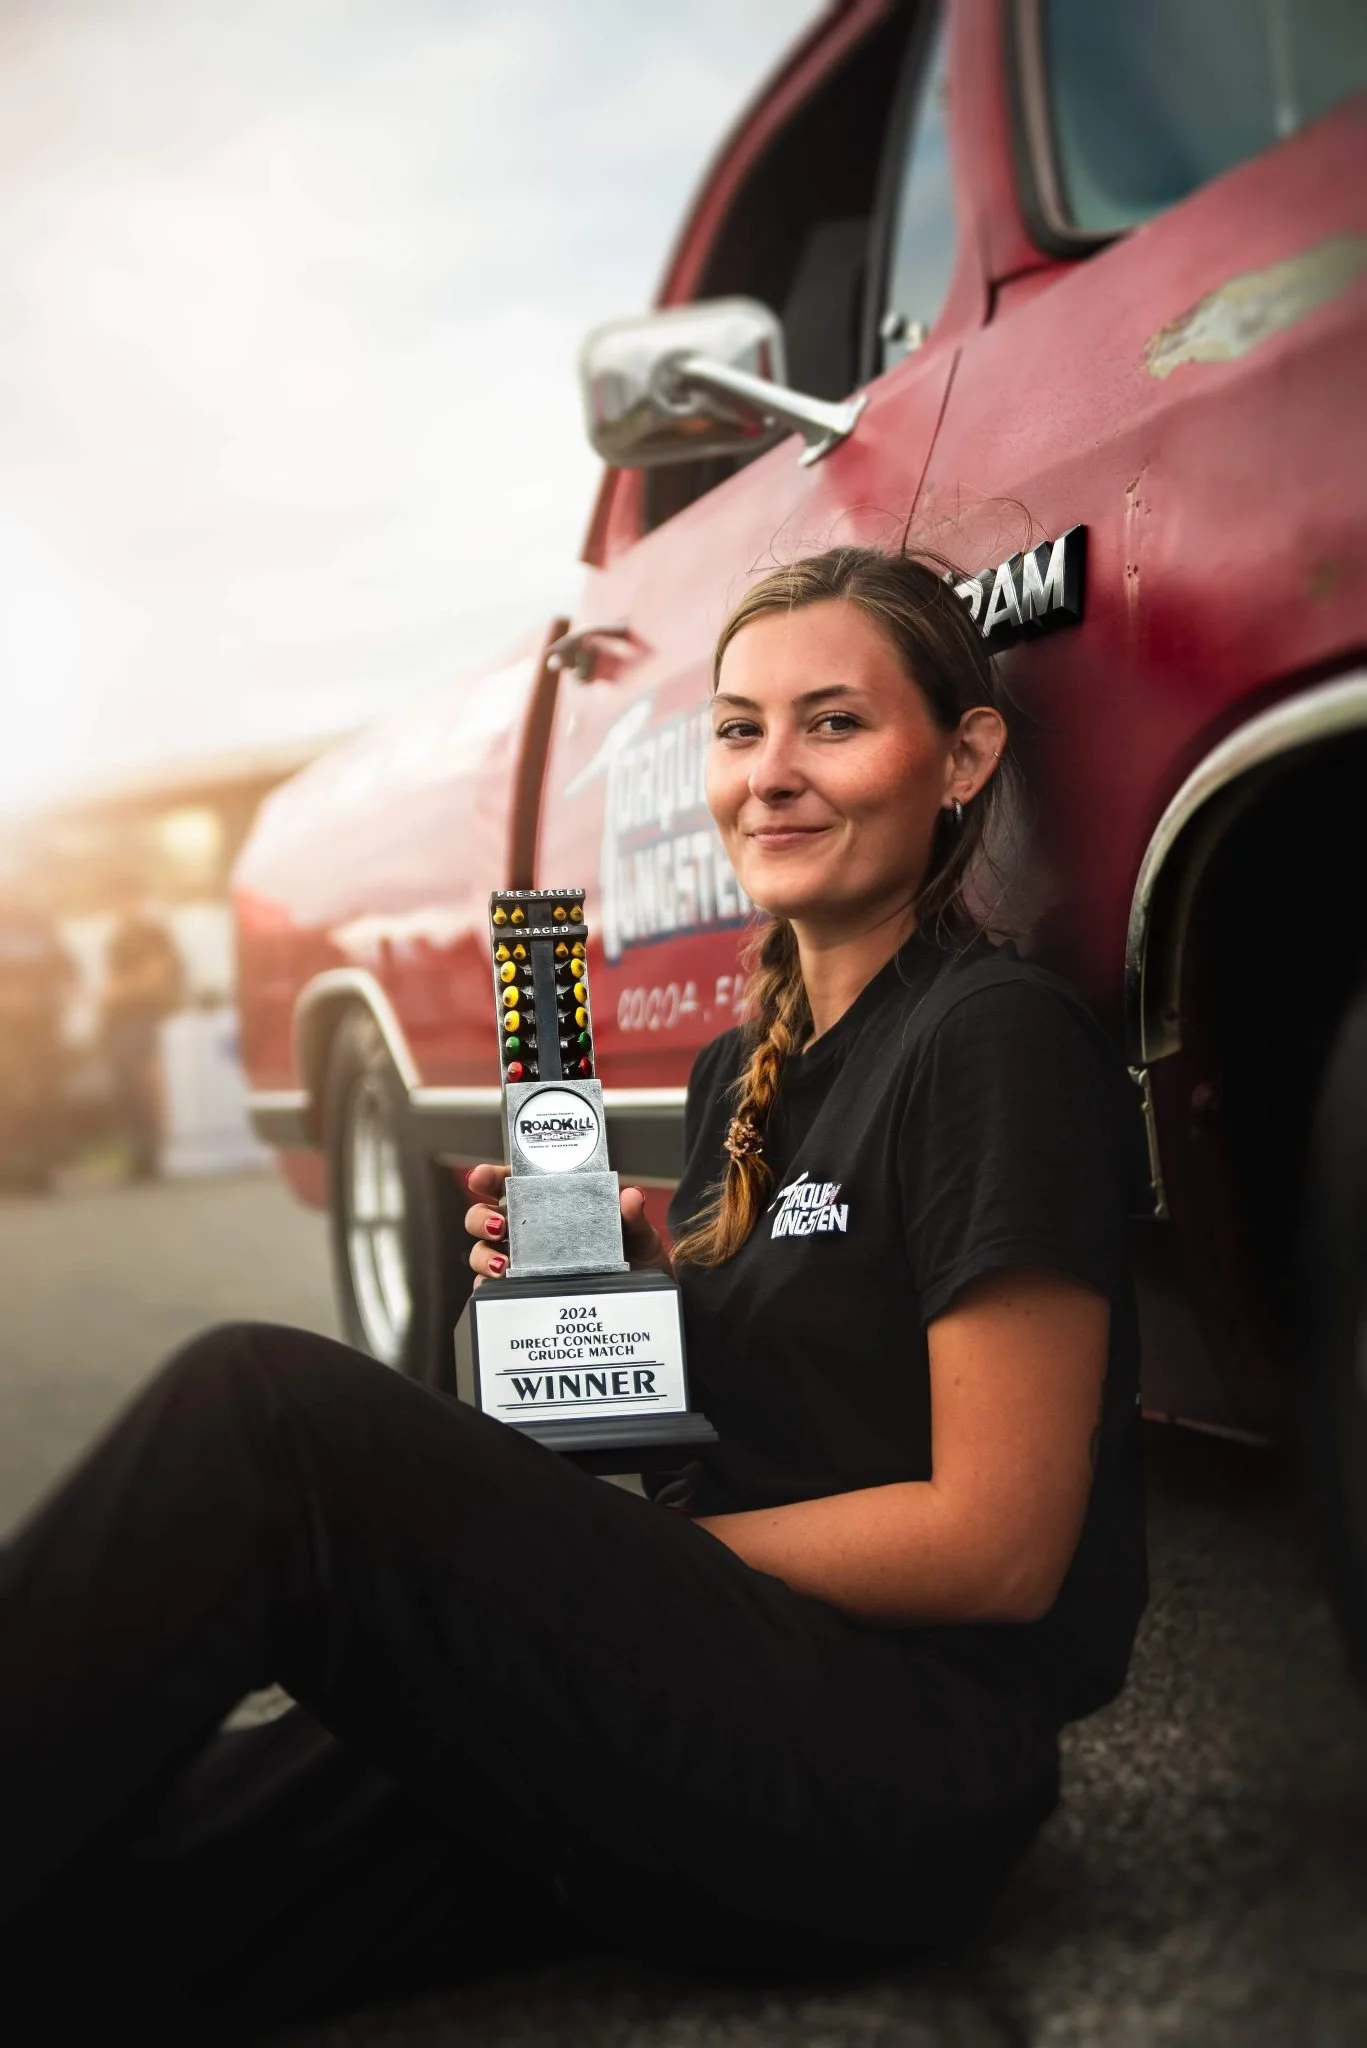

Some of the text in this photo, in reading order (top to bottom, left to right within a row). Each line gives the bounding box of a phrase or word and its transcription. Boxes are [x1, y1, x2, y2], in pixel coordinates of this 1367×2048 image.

[496, 888, 584, 898] PRE-STAGED
[515, 926, 569, 936] STAGED
[519, 1117, 594, 1135] ROADKILL
[559, 1306, 598, 1320] 2024
[555, 1322, 604, 1335] DODGE
[510, 1332, 651, 1350] DIRECT CONNECTION
[528, 1345, 635, 1361] GRUDGE MATCH
[511, 1370, 656, 1401] WINNER
